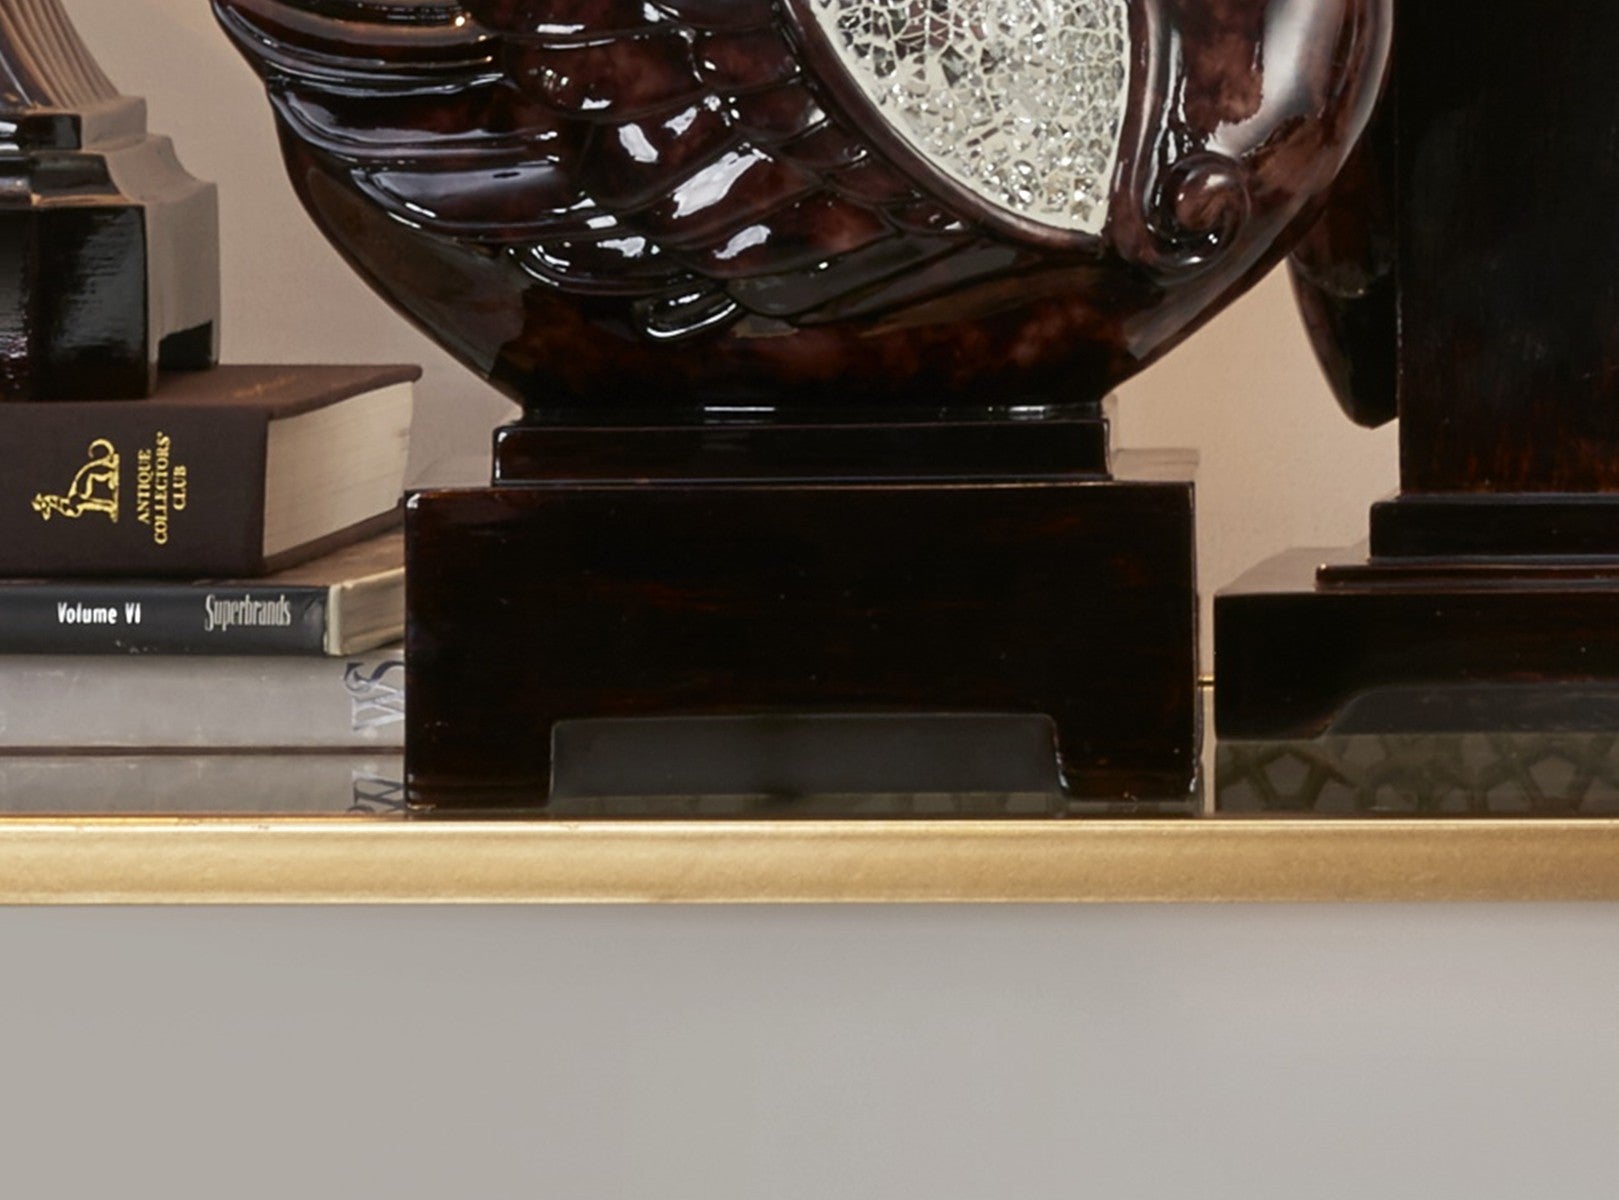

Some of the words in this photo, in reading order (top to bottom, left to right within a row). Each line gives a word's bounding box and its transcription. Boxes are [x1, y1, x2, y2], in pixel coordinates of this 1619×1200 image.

[137, 448, 154, 525] ANTIQUE
[172, 465, 187, 510] CLUB
[57, 602, 117, 624] Volume
[125, 602, 141, 624] VI
[204, 593, 292, 632] Superbrands
